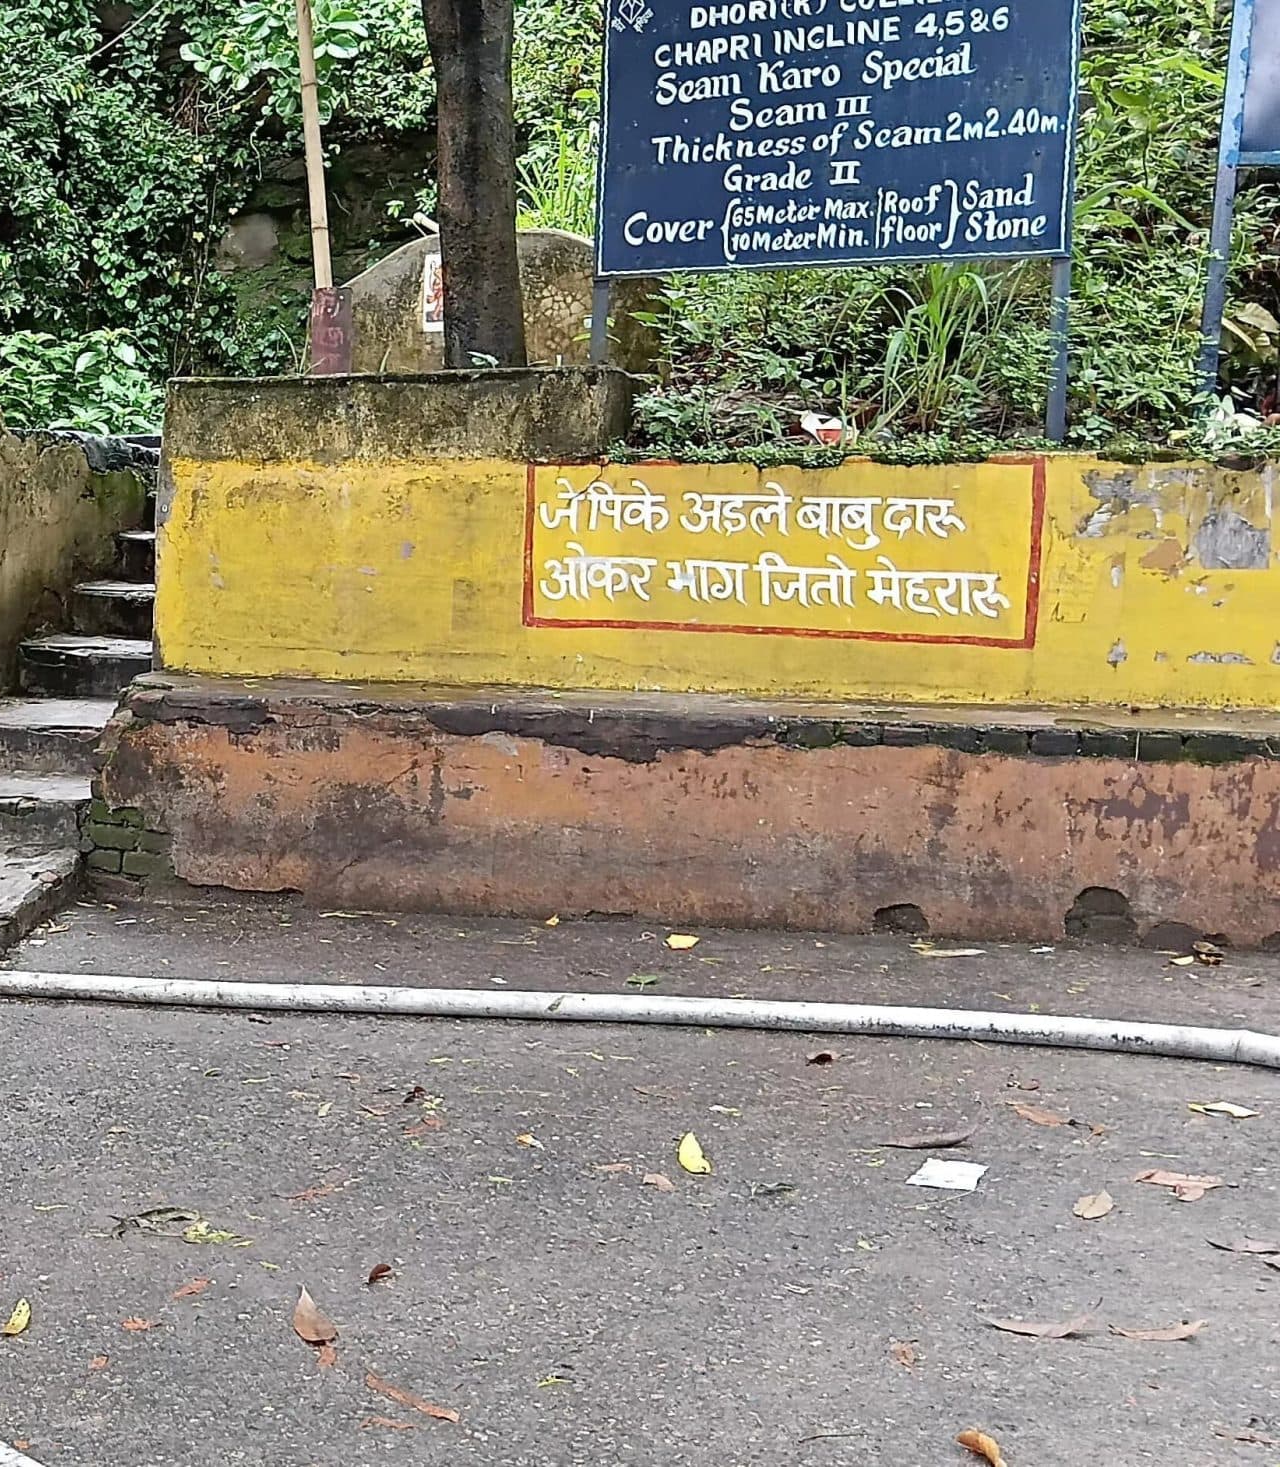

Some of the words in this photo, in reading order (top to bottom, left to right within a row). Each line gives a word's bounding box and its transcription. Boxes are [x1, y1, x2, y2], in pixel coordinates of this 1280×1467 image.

[654, 32, 762, 68] CHAPRI
[773, 15, 901, 56] INCLINE
[655, 72, 741, 105] Seam
[757, 60, 841, 94] Karo
[861, 42, 976, 90] Special
[729, 98, 827, 131] Seam
[835, 96, 872, 117] III
[651, 133, 807, 165] Thickness
[812, 122, 849, 156] of
[853, 120, 942, 150] Seam
[723, 160, 814, 193] Grade
[829, 160, 861, 186] II
[824, 197, 875, 221] Max.
[884, 184, 942, 216] Roof
[962, 172, 1035, 211] Sand
[624, 211, 714, 247] Cover
[817, 222, 870, 249] Min.
[965, 211, 1048, 242] Stone
[679, 481, 793, 537] अइले
[666, 559, 750, 606] भाग
[752, 551, 857, 608] जितो
